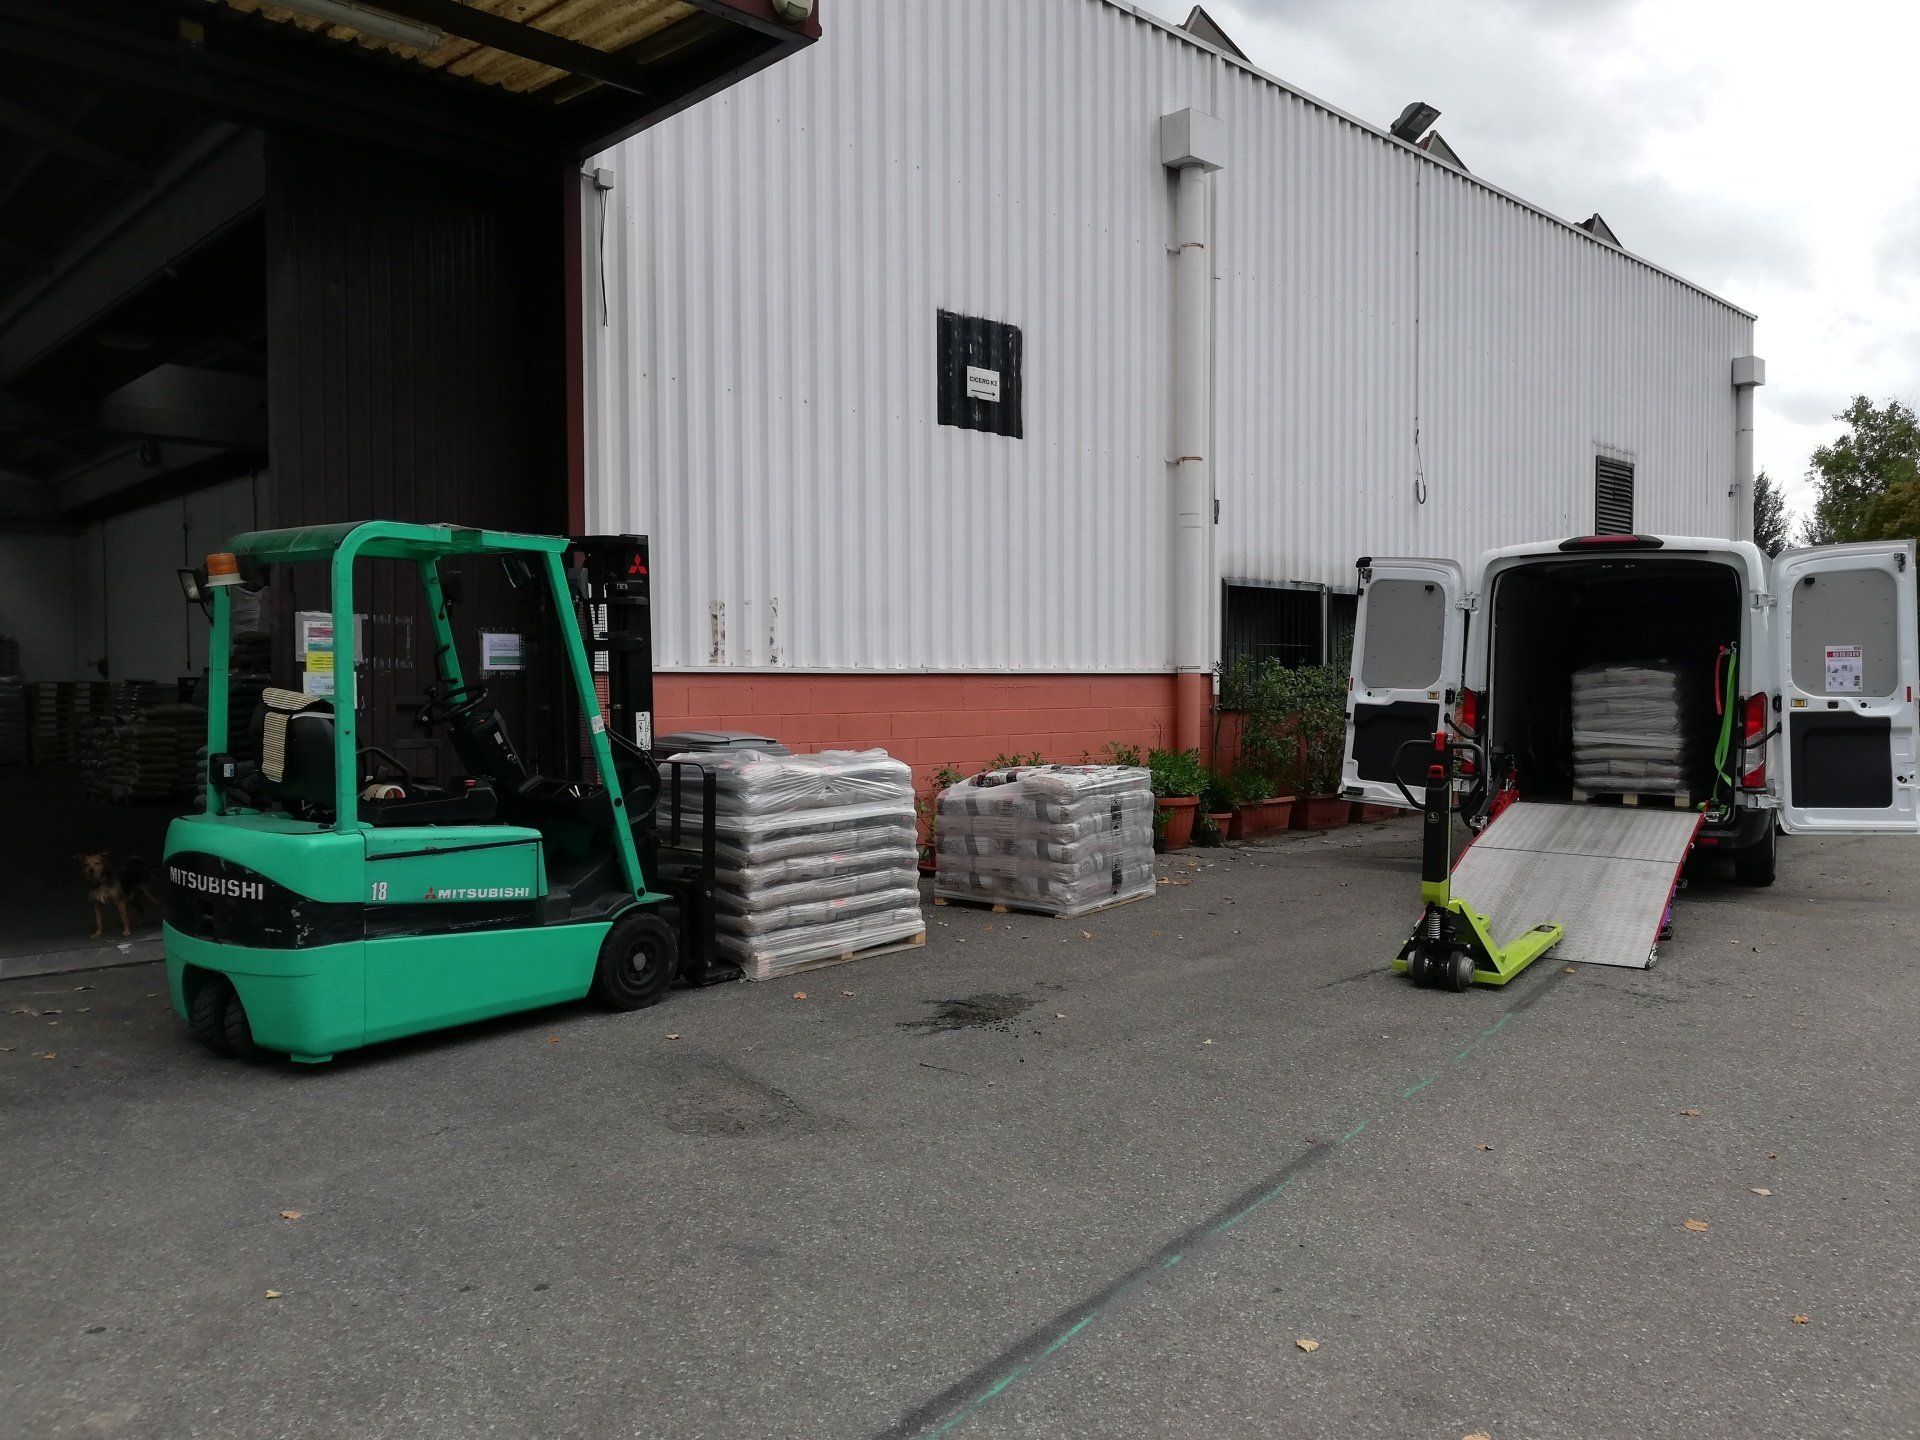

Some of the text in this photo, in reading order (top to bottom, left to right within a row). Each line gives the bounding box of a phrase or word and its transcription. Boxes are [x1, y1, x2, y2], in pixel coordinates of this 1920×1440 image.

[969, 376, 990, 385] CICERO
[169, 866, 264, 901] MITSUBISHI
[371, 881, 388, 901] 18
[437, 887, 530, 899] MITSUBISHI
